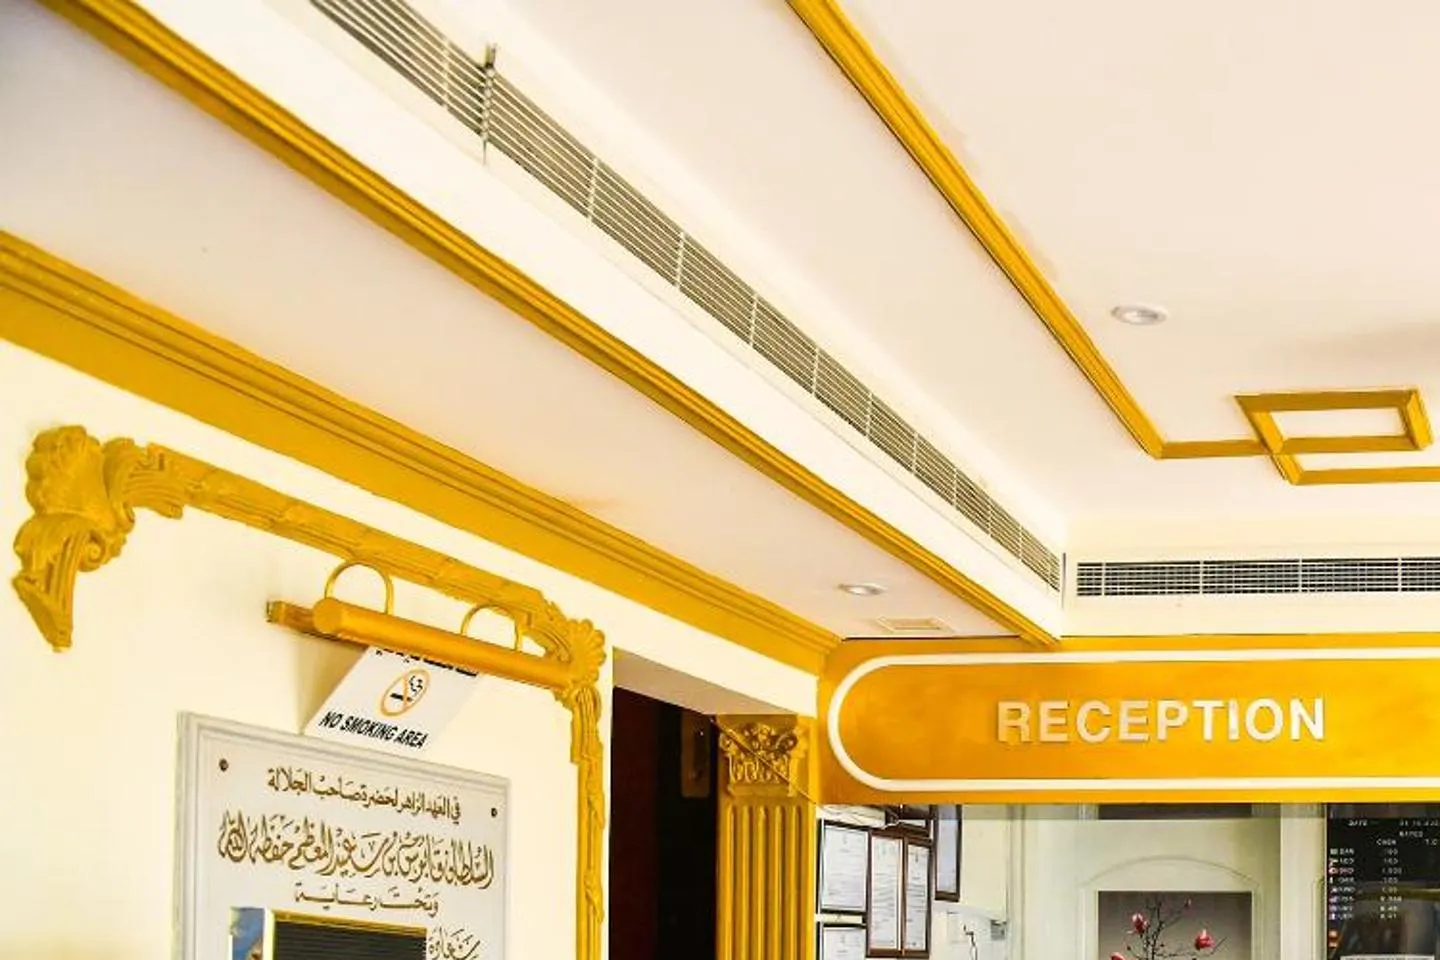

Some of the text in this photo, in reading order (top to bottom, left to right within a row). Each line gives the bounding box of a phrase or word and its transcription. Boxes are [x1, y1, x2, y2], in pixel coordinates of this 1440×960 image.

[318, 711, 430, 749] NO SMOKING AREA
[997, 698, 1325, 742] RECEPTION
[267, 766, 313, 797] الجلالة
[313, 775, 361, 800] صاحب
[426, 792, 450, 820] العهد
